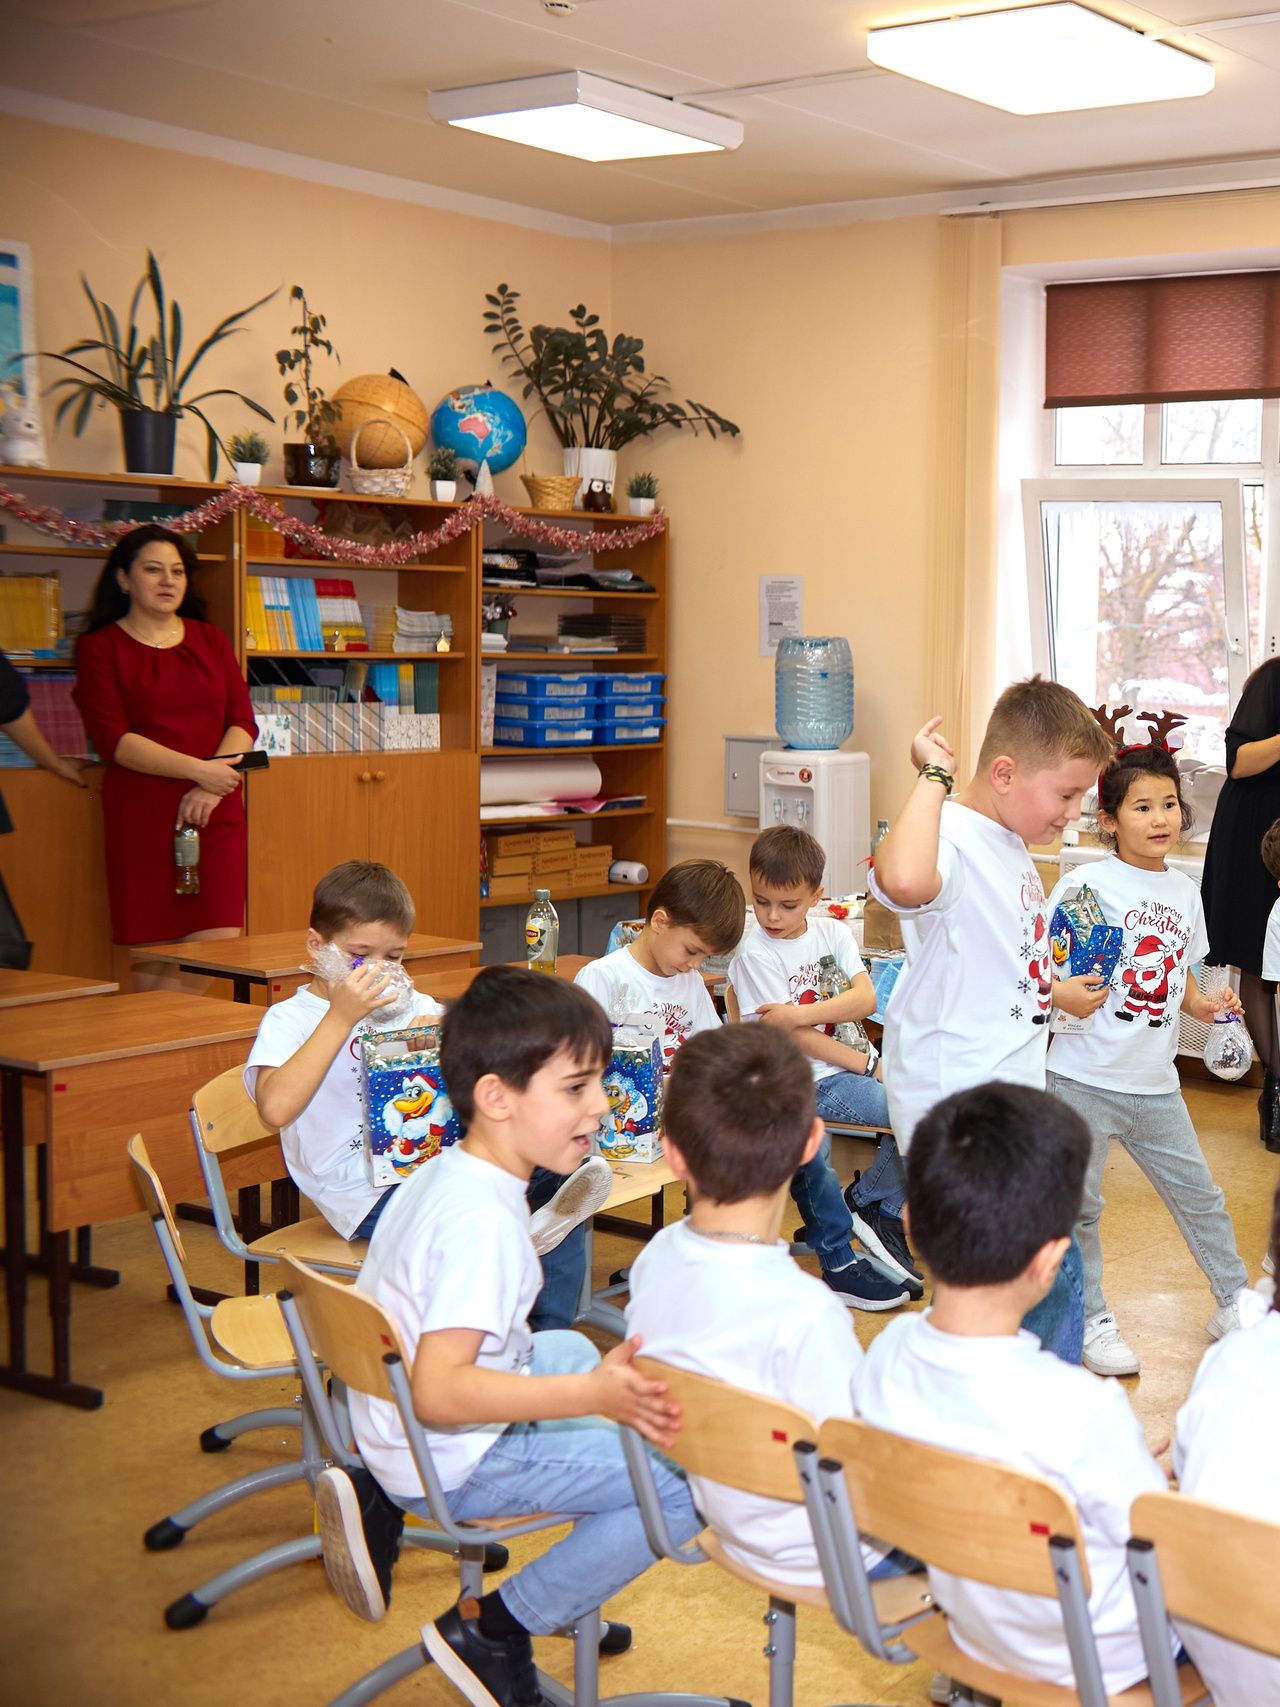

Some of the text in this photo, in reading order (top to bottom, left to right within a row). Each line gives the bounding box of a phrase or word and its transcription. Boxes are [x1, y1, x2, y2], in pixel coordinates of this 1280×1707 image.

[1151, 901, 1183, 923] Merry
[1124, 910, 1191, 949] Christmas
[660, 1002, 688, 1019] Merry
